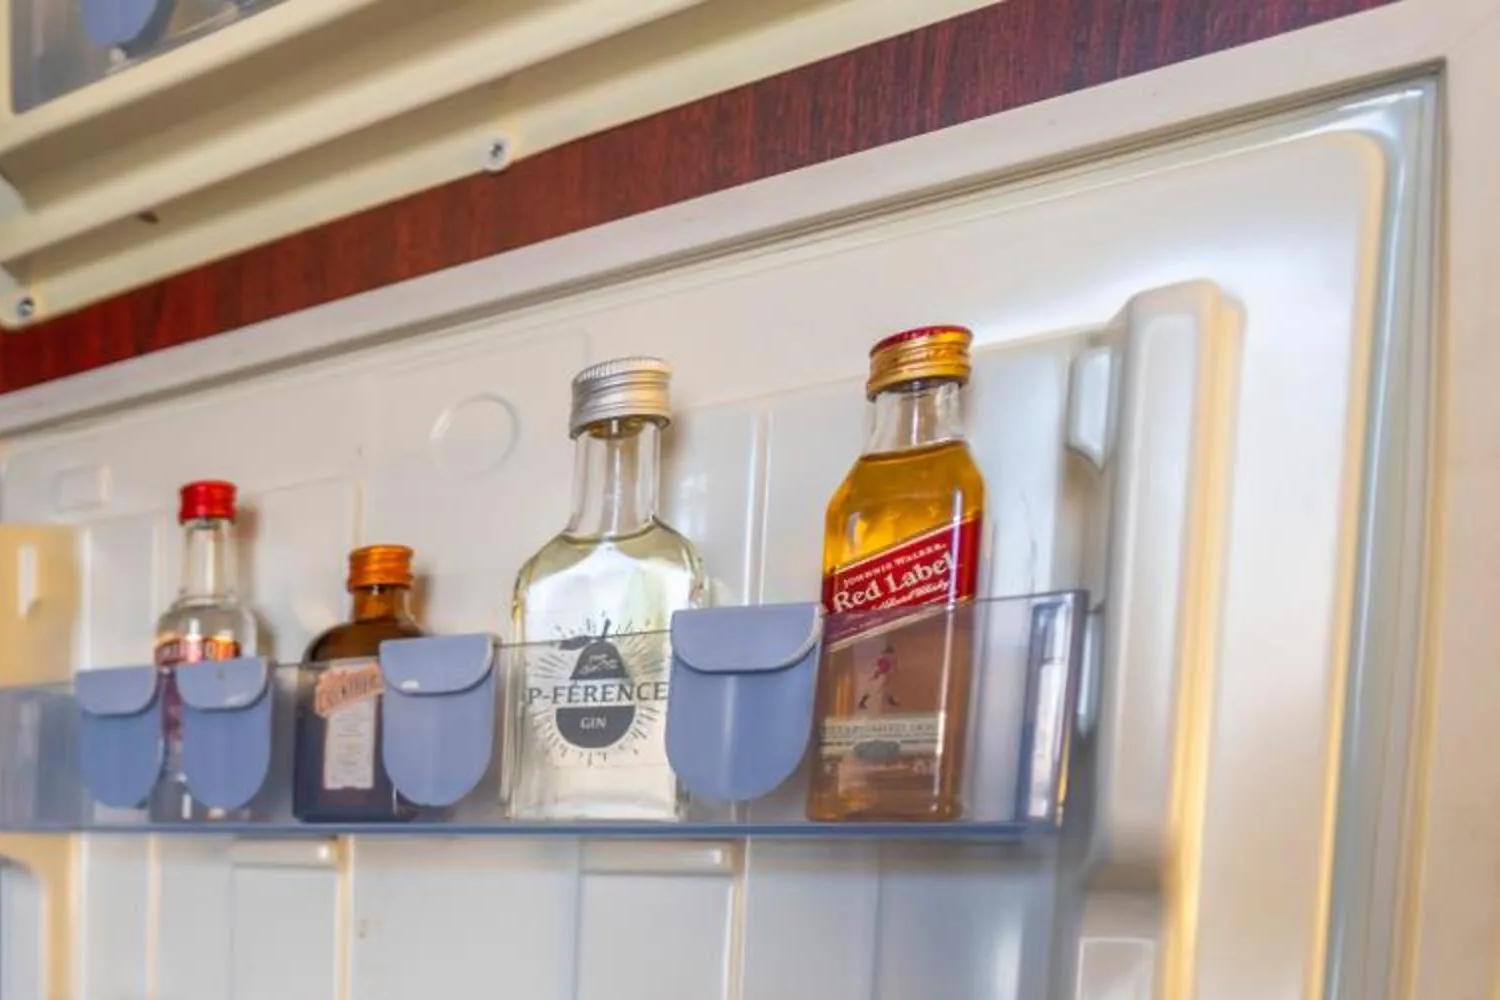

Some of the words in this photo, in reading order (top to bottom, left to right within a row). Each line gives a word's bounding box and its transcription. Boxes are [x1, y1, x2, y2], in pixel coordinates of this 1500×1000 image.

[833, 580, 883, 613] Red
[886, 551, 956, 593] Label
[580, 716, 607, 730] GIN
